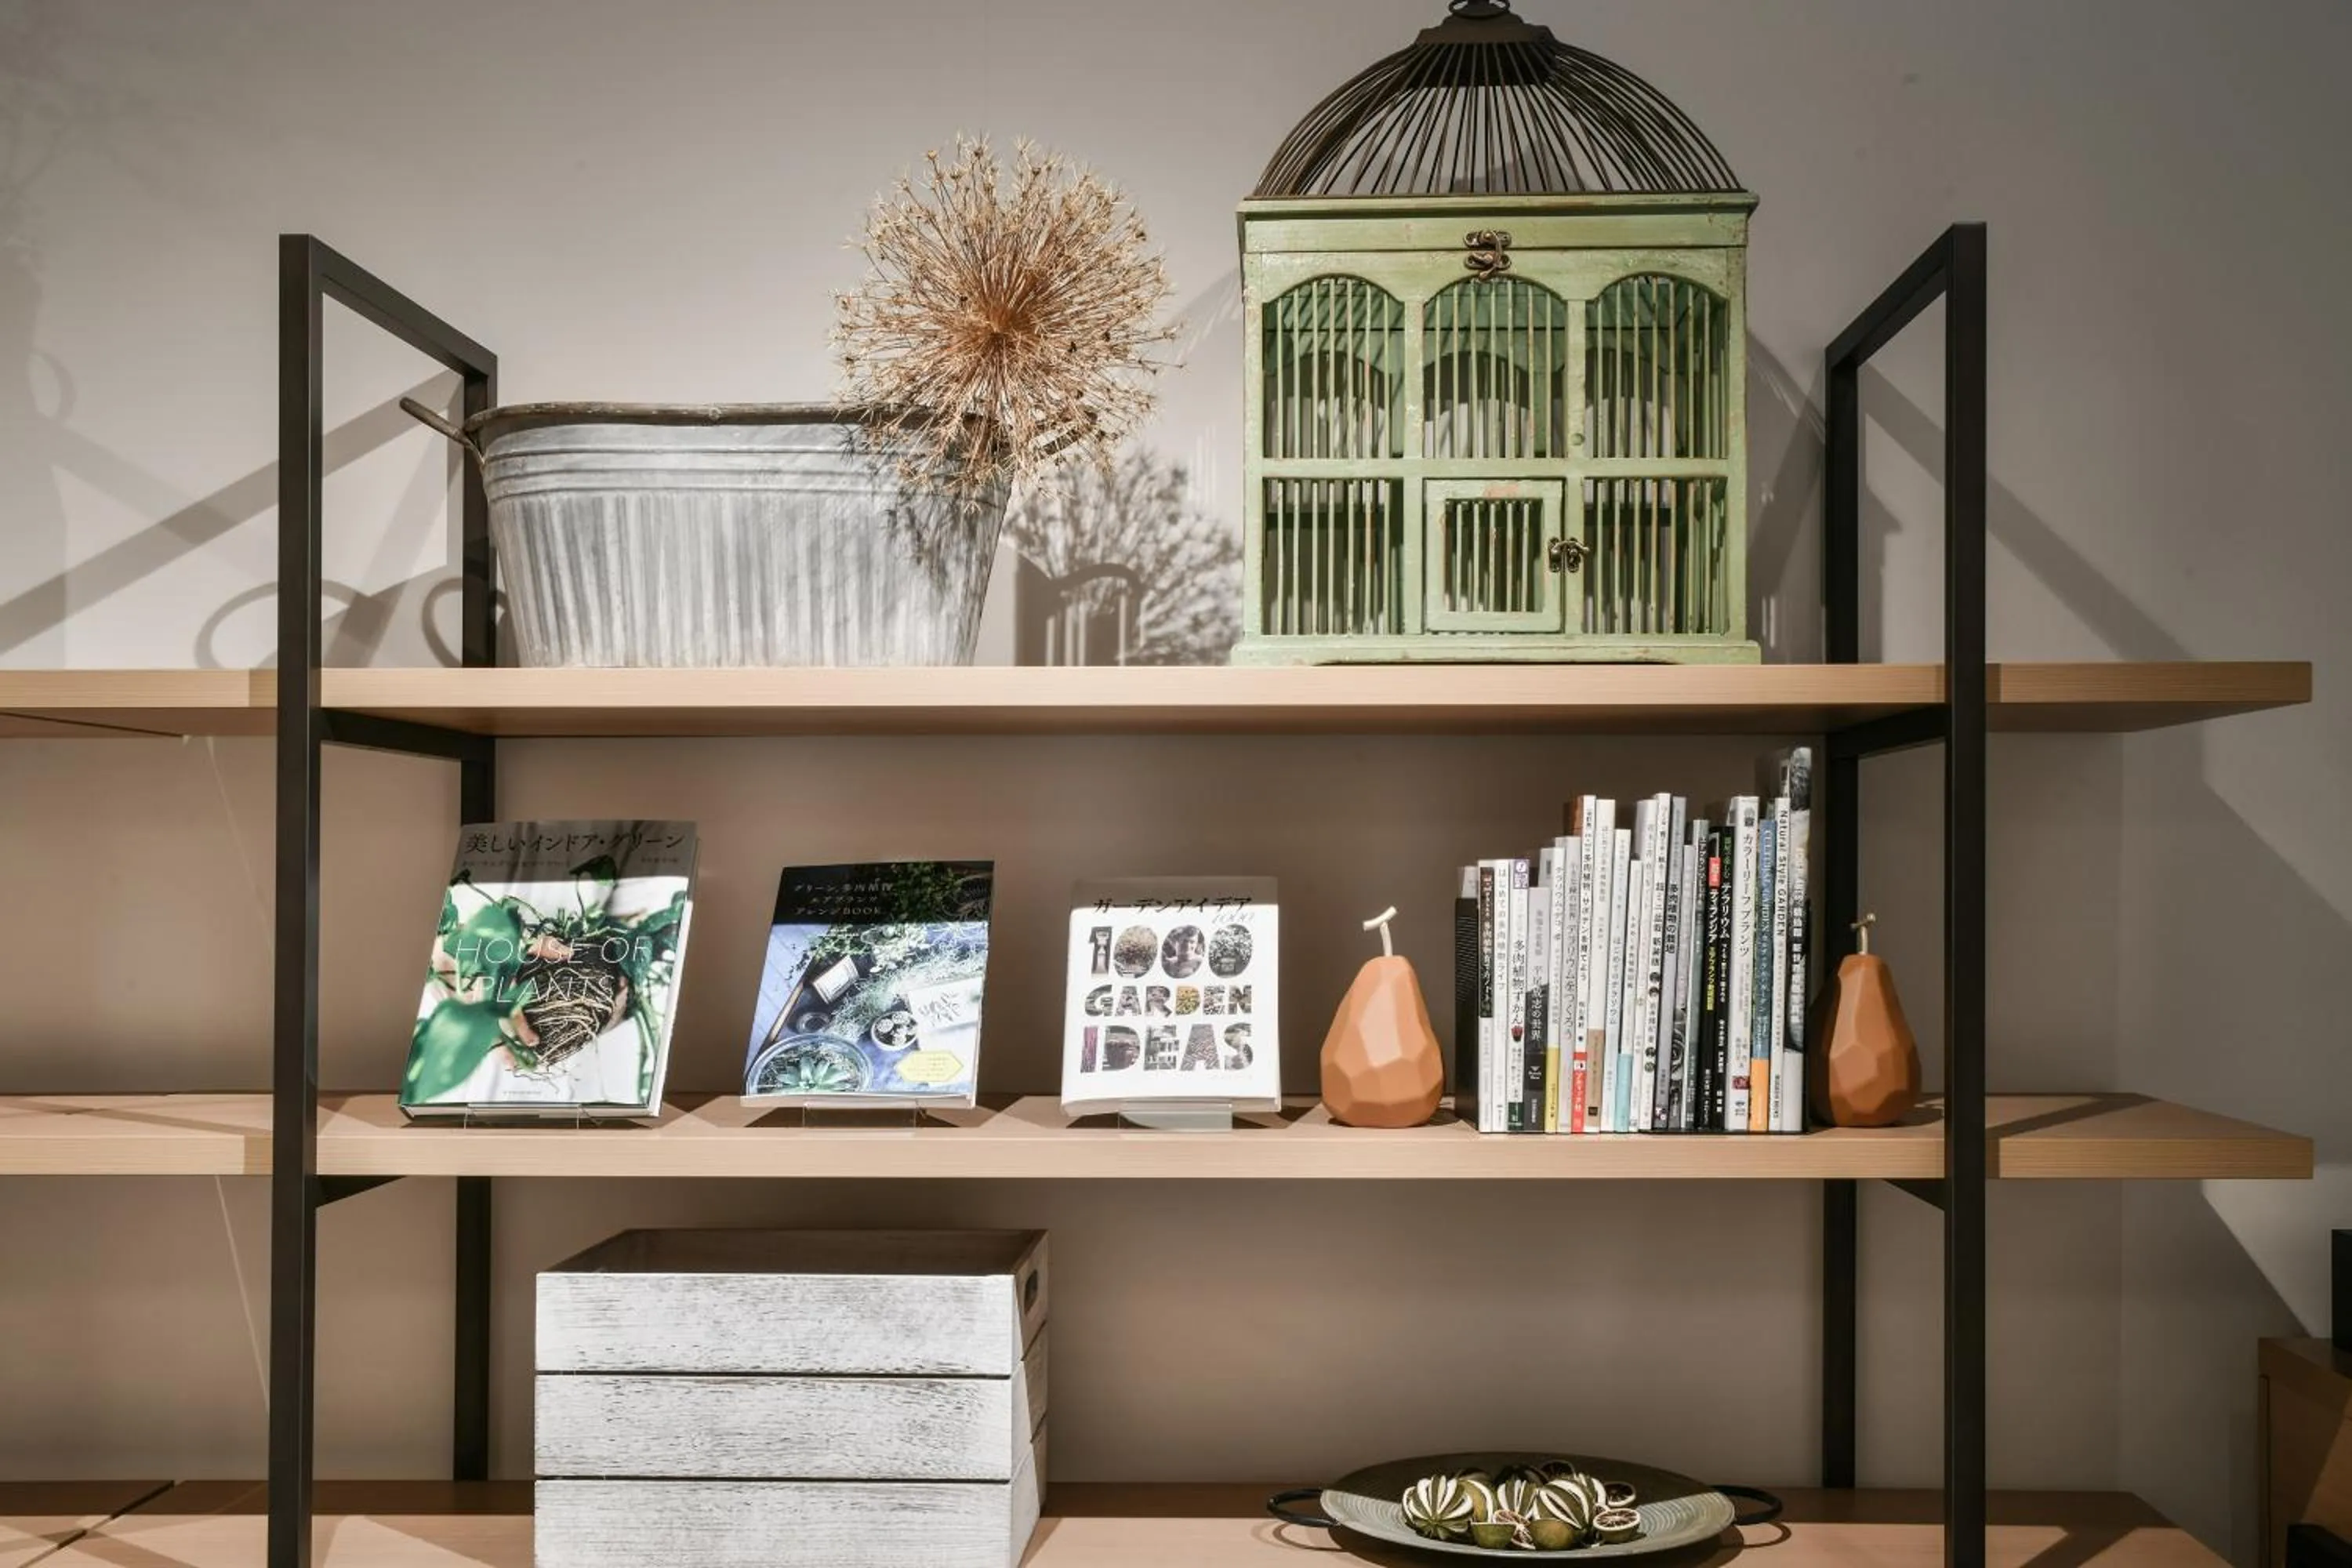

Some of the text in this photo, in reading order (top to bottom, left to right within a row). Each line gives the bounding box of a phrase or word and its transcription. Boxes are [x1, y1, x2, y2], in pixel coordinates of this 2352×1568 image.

[463, 831, 685, 855] 美しいインドア・グリーン
[1779, 809, 1788, 851] Natural
[1777, 855, 1787, 885] Style
[1093, 898, 1252, 913] ガーデンアイデア
[1719, 882, 1731, 938] テラリウム
[1777, 889, 1787, 936] GARDEN
[456, 936, 652, 964] HOUSE OF
[1090, 924, 1254, 979] 1000
[471, 975, 616, 1004] PLANTS
[1084, 984, 1253, 1018] GARDEN
[1512, 940, 1525, 1025] 多肉植物ずかん
[1080, 1022, 1254, 1073] IDEAS
